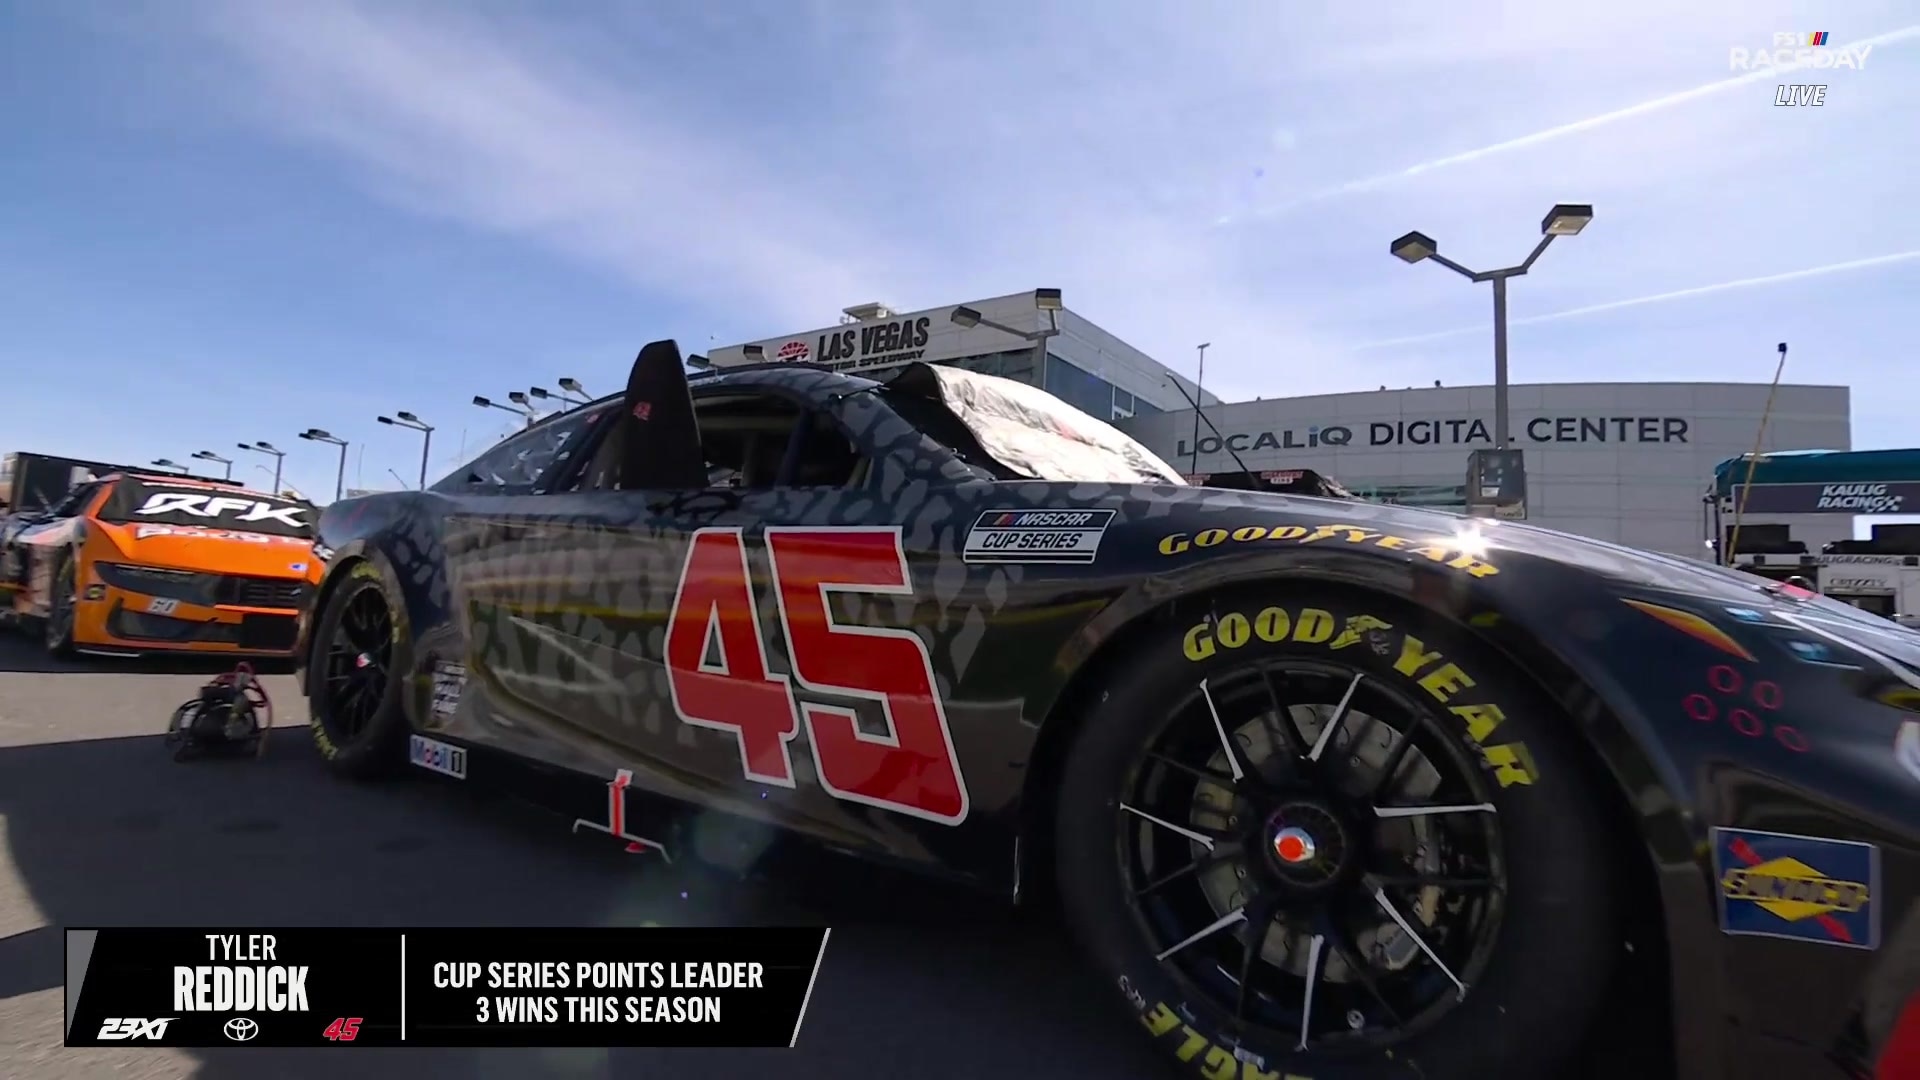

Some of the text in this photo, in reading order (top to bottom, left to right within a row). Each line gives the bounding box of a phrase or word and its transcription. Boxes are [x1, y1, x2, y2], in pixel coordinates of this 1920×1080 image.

[817, 317, 930, 362] LAS VEGAS
[1527, 417, 1689, 443] CENTER
[1823, 484, 1888, 496] KAULIG
[134, 493, 311, 528] RFK
[1817, 496, 1886, 508] RACING
[1014, 513, 1094, 526] NASCAR
[982, 533, 1083, 548] CUP SERIES
[663, 526, 969, 827] 45
